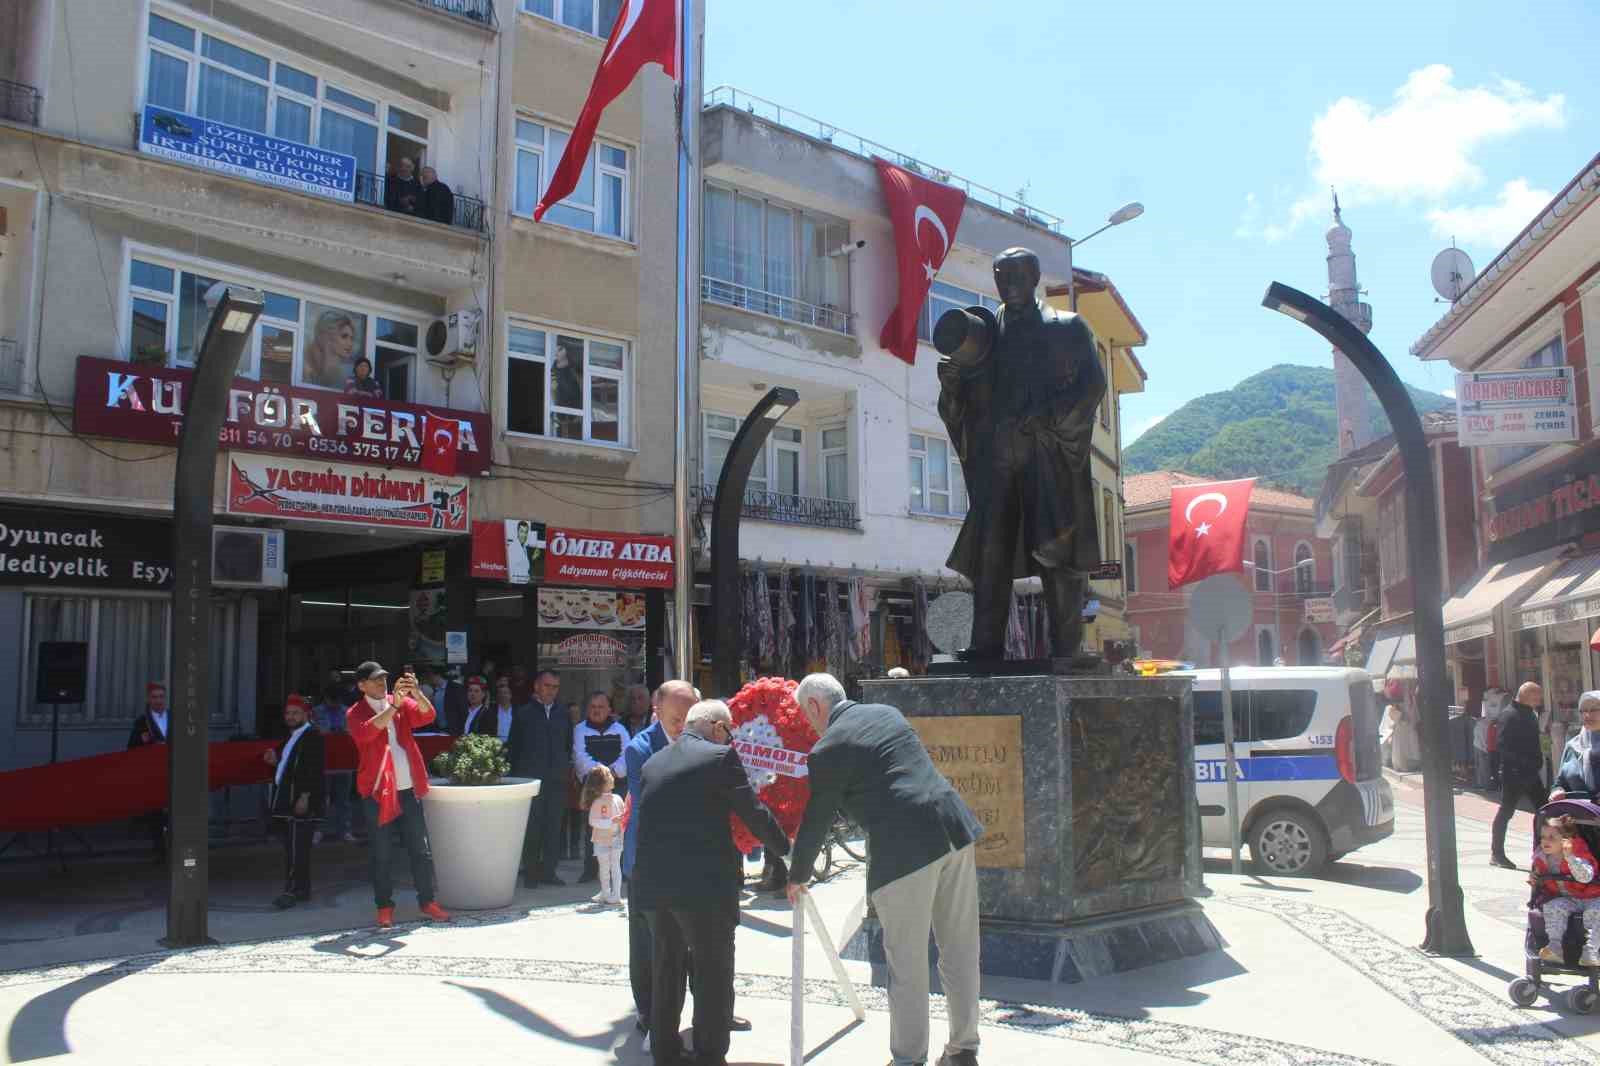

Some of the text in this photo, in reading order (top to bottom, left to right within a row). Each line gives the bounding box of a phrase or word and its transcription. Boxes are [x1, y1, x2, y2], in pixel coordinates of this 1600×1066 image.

[152, 132, 248, 165] İRTİBAT
[255, 160, 348, 190] BÜROSU
[198, 134, 281, 165] SÜRÜCÜ
[287, 158, 349, 180] KURSU
[207, 124, 344, 168] ÖZEL UZUNER
[105, 371, 479, 453] KUFÖR FERA
[247, 429, 268, 445] 54
[272, 431, 292, 448] 70
[308, 437, 348, 454] 0536
[352, 442, 380, 459] 375
[385, 446, 399, 460] 17
[403, 447, 422, 463] 47
[265, 464, 426, 503] YASEMİN DİKİMEVİ
[550, 532, 674, 564] ÖMER AYBA
[132, 560, 175, 584] Eşy
[559, 564, 608, 578] Adıyaman
[1315, 735, 1333, 745] 153
[1195, 761, 1245, 781] BITA
